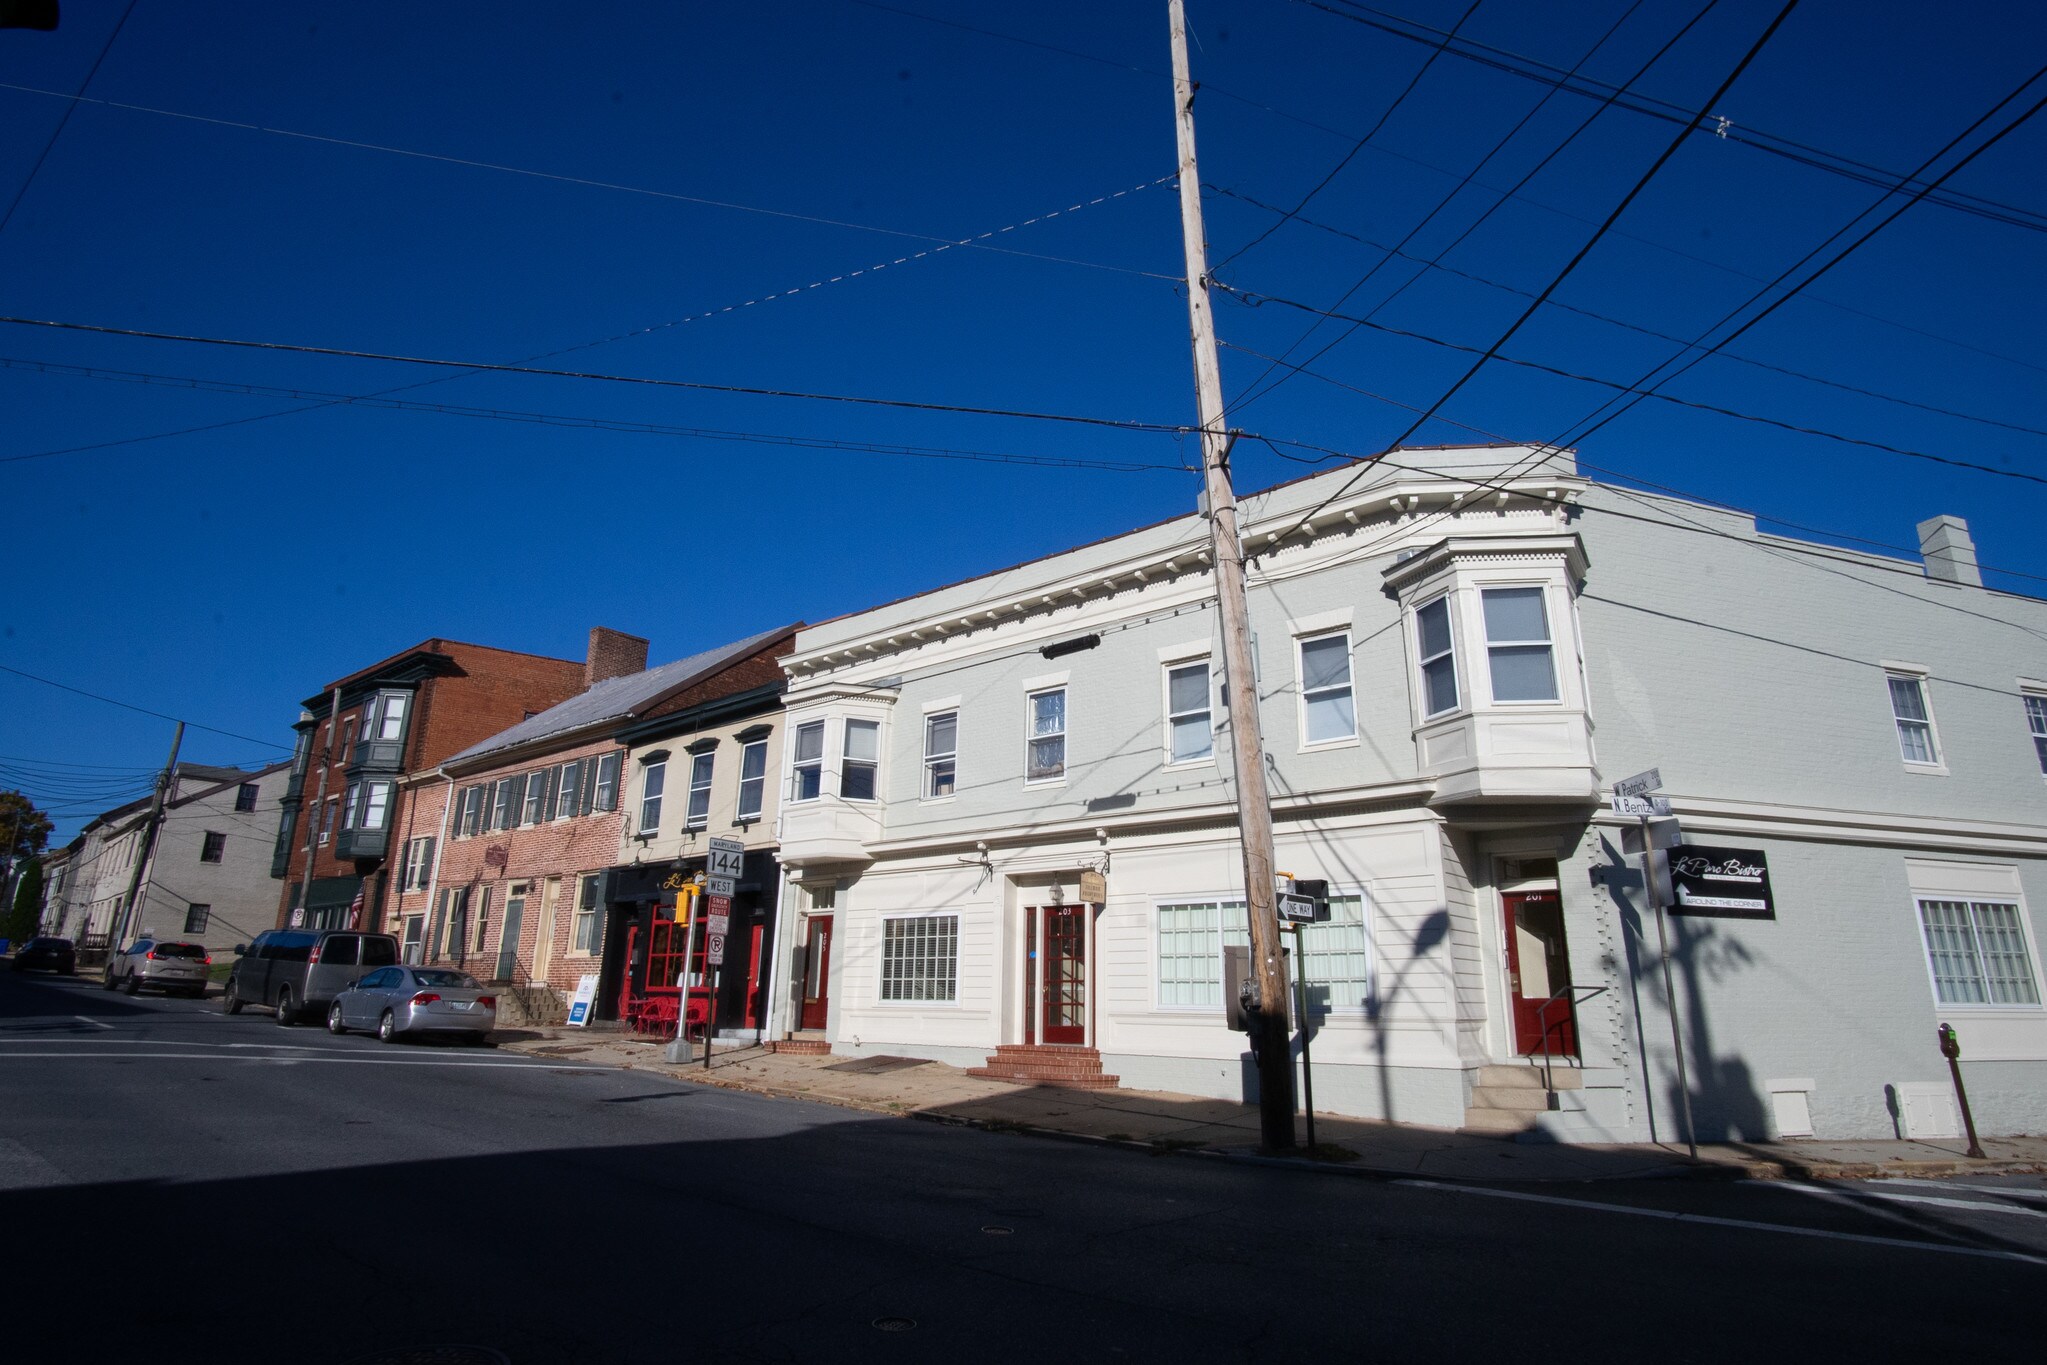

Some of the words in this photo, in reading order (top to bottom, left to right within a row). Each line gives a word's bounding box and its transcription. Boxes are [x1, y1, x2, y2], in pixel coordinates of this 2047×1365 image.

[1621, 779, 1649, 796] Patrick
[1624, 798, 1652, 813] Bentz
[713, 841, 740, 851] MARYLAND
[711, 851, 740, 874] 144
[1670, 856, 1699, 878] Le
[1688, 857, 1721, 873] Parc
[1723, 859, 1766, 876] Bistro
[710, 880, 731, 893] WEST
[1287, 902, 1298, 913] ONE
[1299, 904, 1311, 915] WAY
[1734, 900, 1762, 908] CORNER
[711, 907, 727, 916] ROUTE
